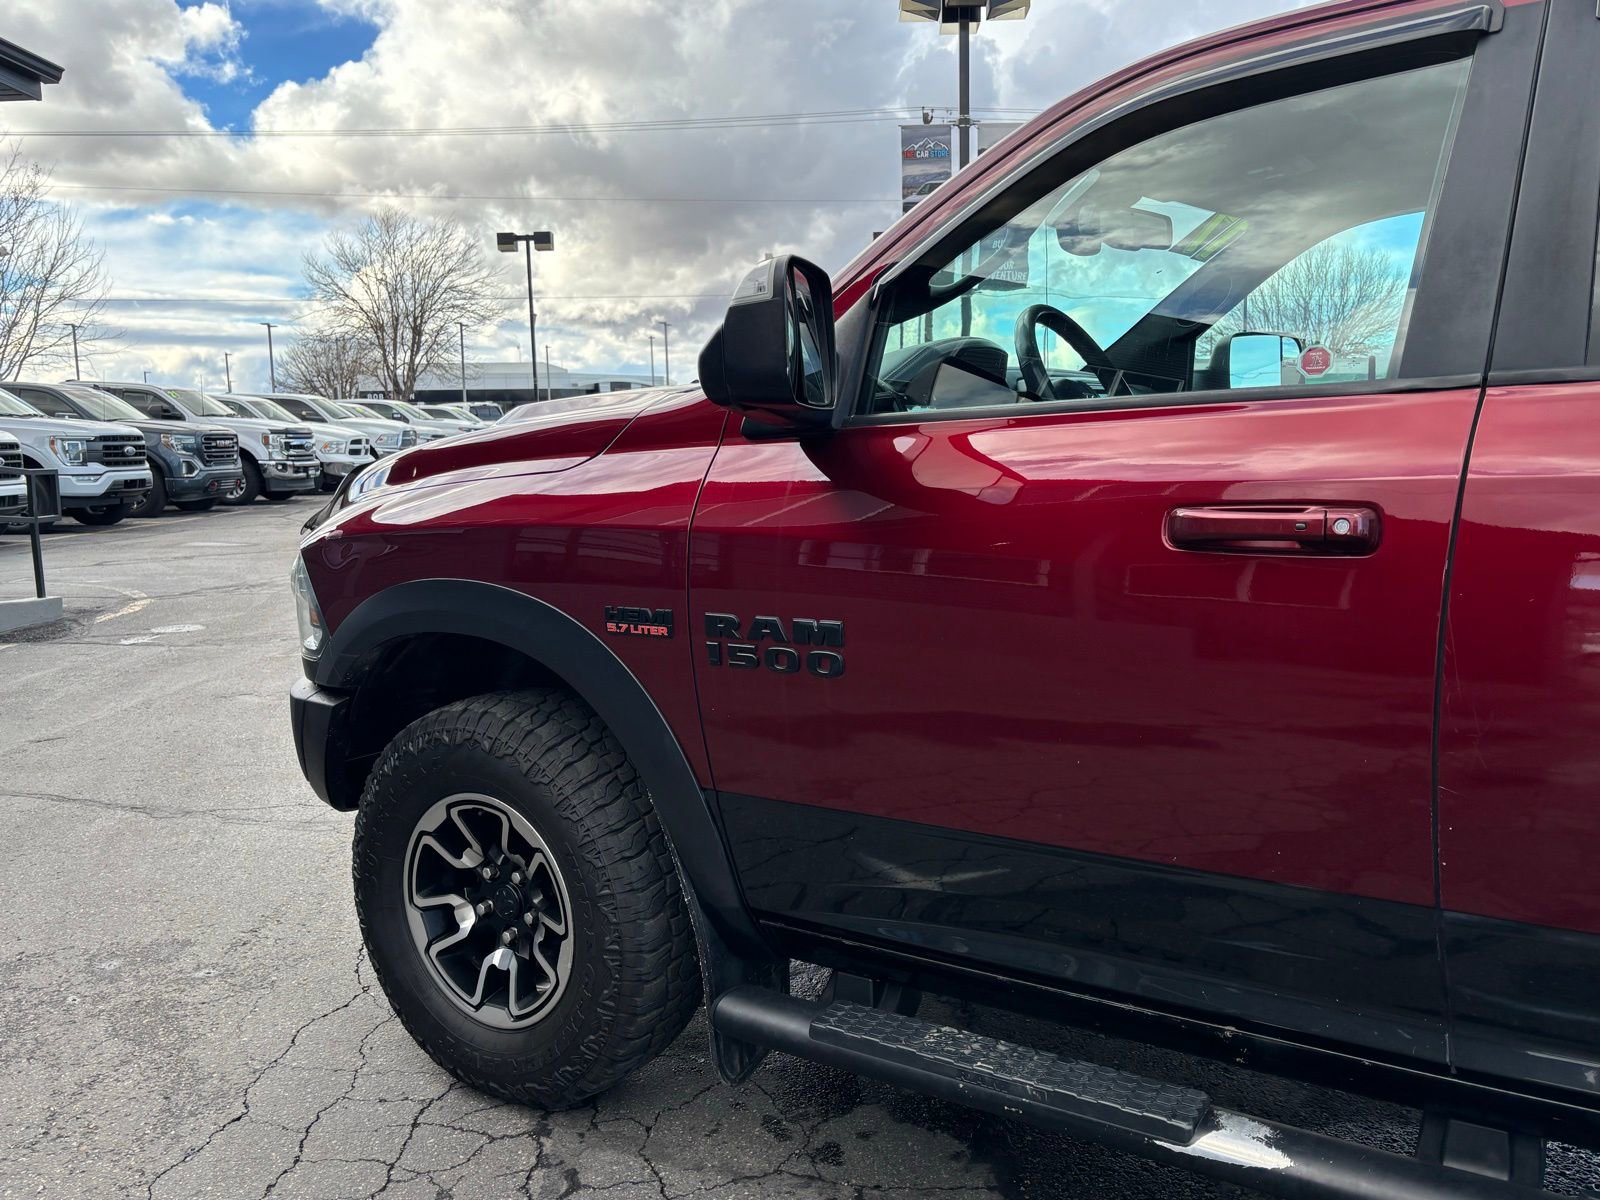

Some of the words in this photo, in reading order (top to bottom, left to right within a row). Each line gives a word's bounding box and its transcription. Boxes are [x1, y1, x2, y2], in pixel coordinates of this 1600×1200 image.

[904, 150, 916, 159] THE
[917, 150, 929, 158] CAR
[930, 149, 950, 158] STORE
[604, 605, 673, 625] HEMI
[606, 622, 629, 633] 5.7
[629, 624, 669, 636] LITER
[704, 611, 845, 648] RAM
[705, 641, 845, 679] 1500
